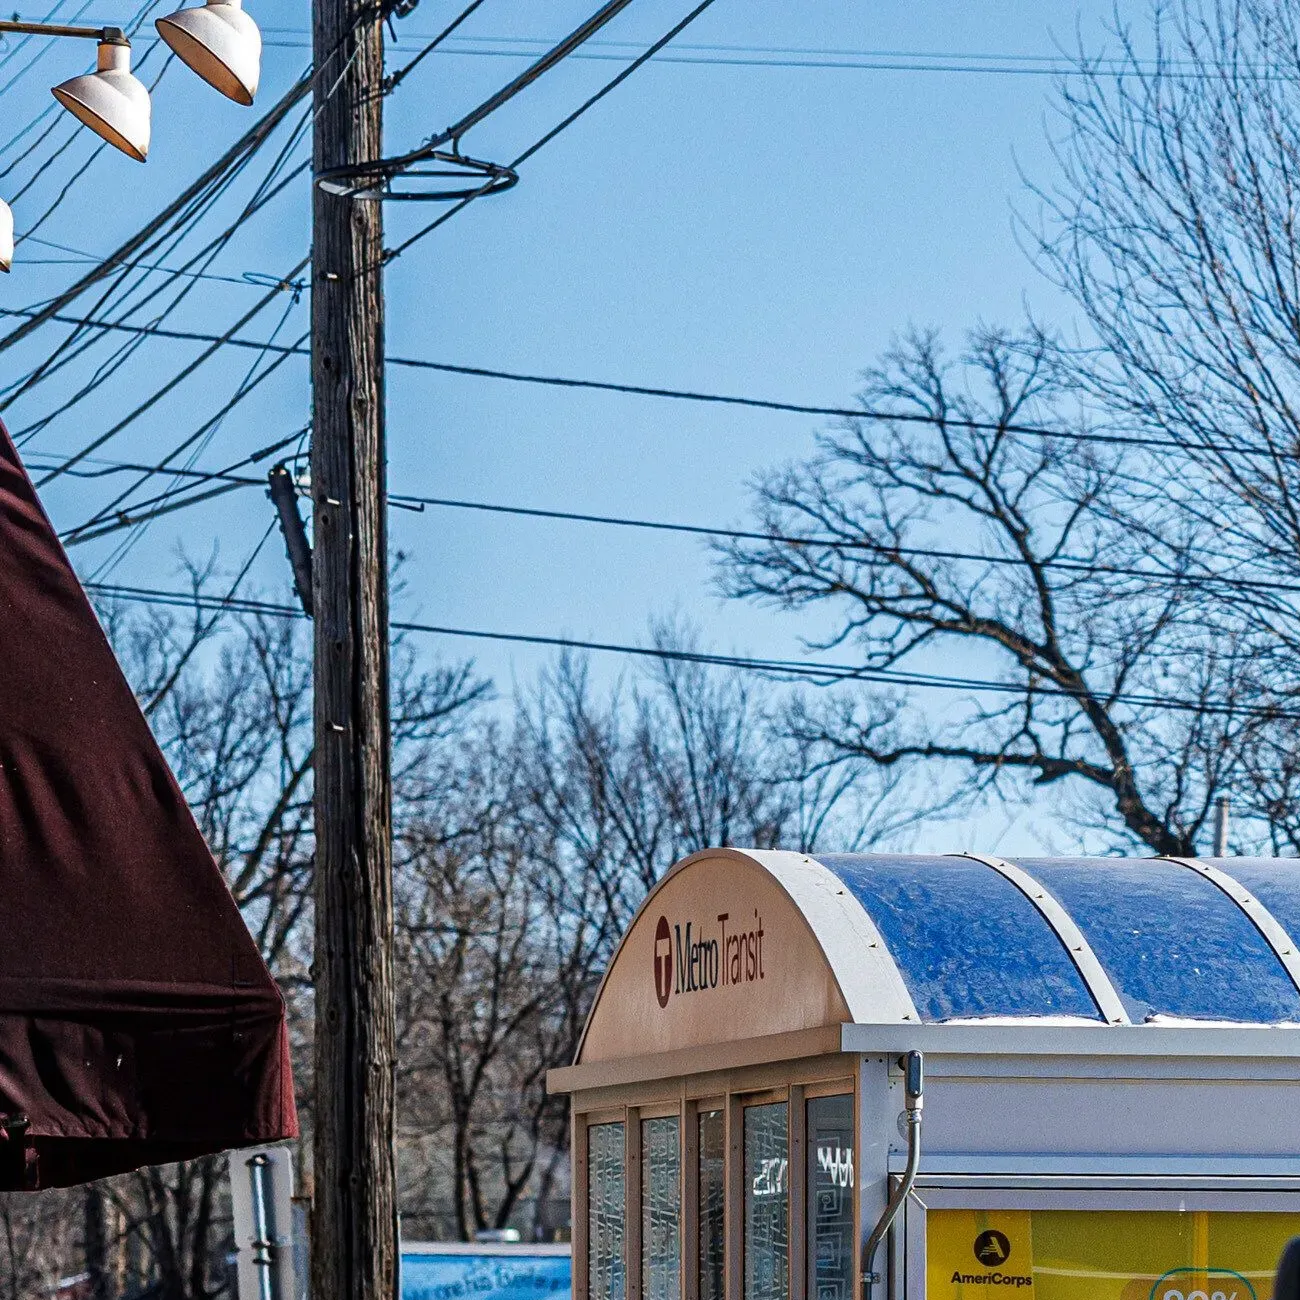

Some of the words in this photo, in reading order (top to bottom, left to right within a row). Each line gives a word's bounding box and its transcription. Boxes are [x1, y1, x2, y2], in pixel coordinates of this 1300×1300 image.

[674, 921, 719, 995] Metro
[717, 908, 765, 986] Transit
[950, 1271, 1033, 1287] AmeriCorps
